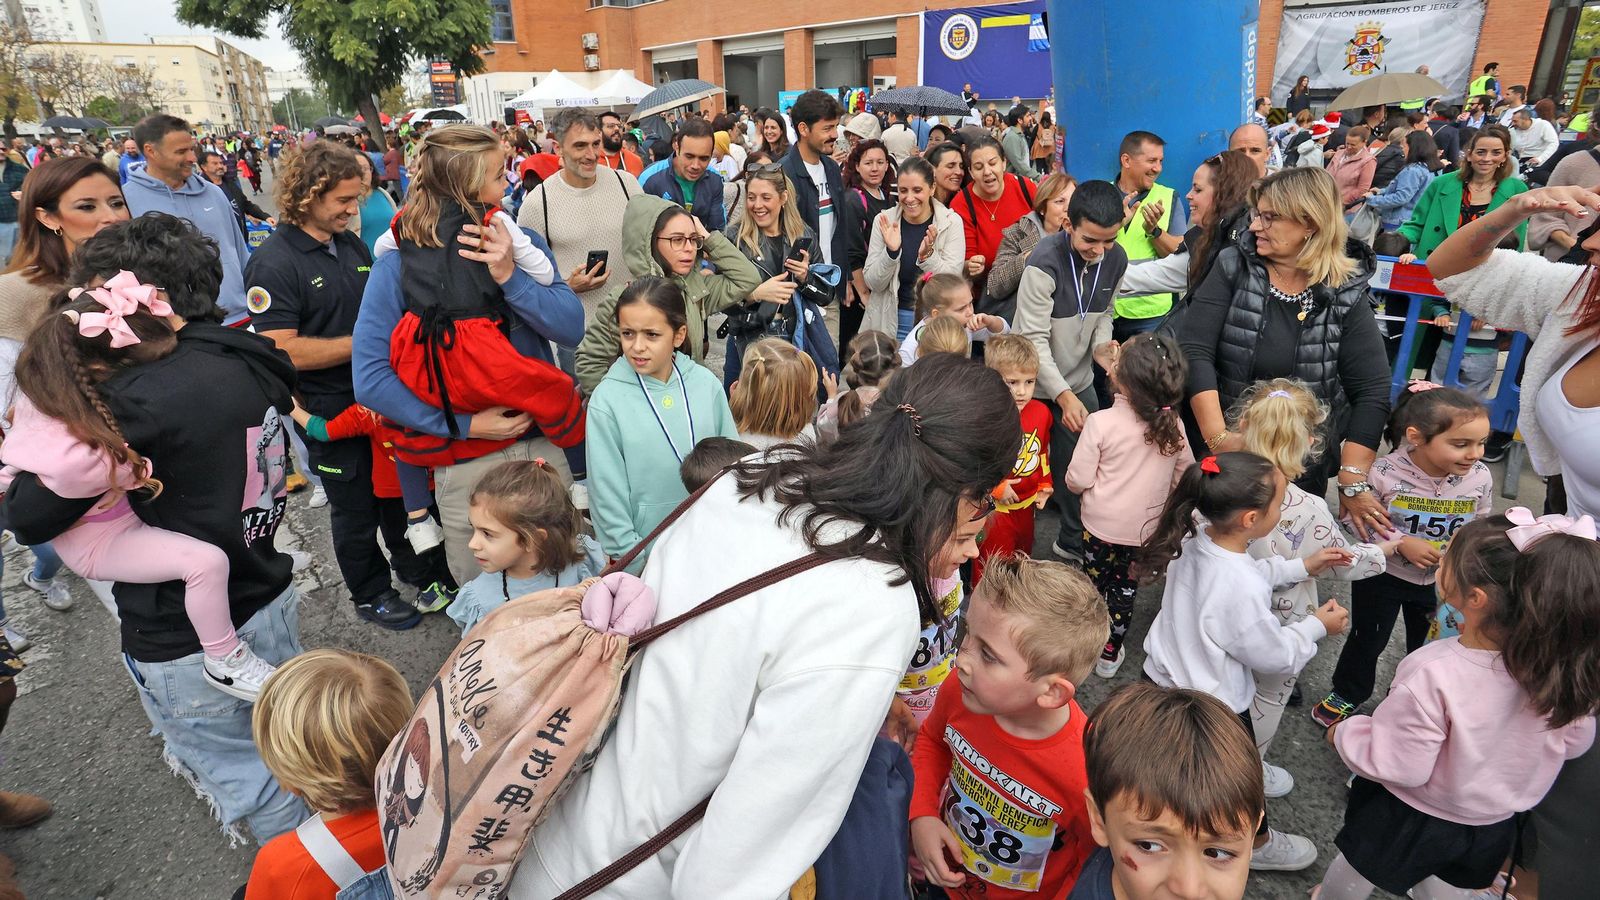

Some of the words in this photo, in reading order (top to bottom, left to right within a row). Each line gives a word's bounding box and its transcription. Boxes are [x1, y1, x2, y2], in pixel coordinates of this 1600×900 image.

[1296, 10, 1356, 21] AGRUPACIÓN
[1358, 6, 1411, 17] BOMBEROS
[1413, 5, 1426, 13] DE
[1428, 2, 1460, 12] JEREZ
[1396, 494, 1425, 505] CARRERA
[1426, 498, 1453, 507] INFANTIL
[1407, 504, 1442, 514] BOMBEROS
[1404, 514, 1465, 538] 156
[458, 718, 479, 752] POETRY
[467, 706, 571, 857] 生き甲斐
[965, 774, 1000, 808] INFANTIL
[1002, 800, 1048, 828] BENEFICA
[986, 803, 997, 817] DE
[998, 811, 1027, 833] JEREZ
